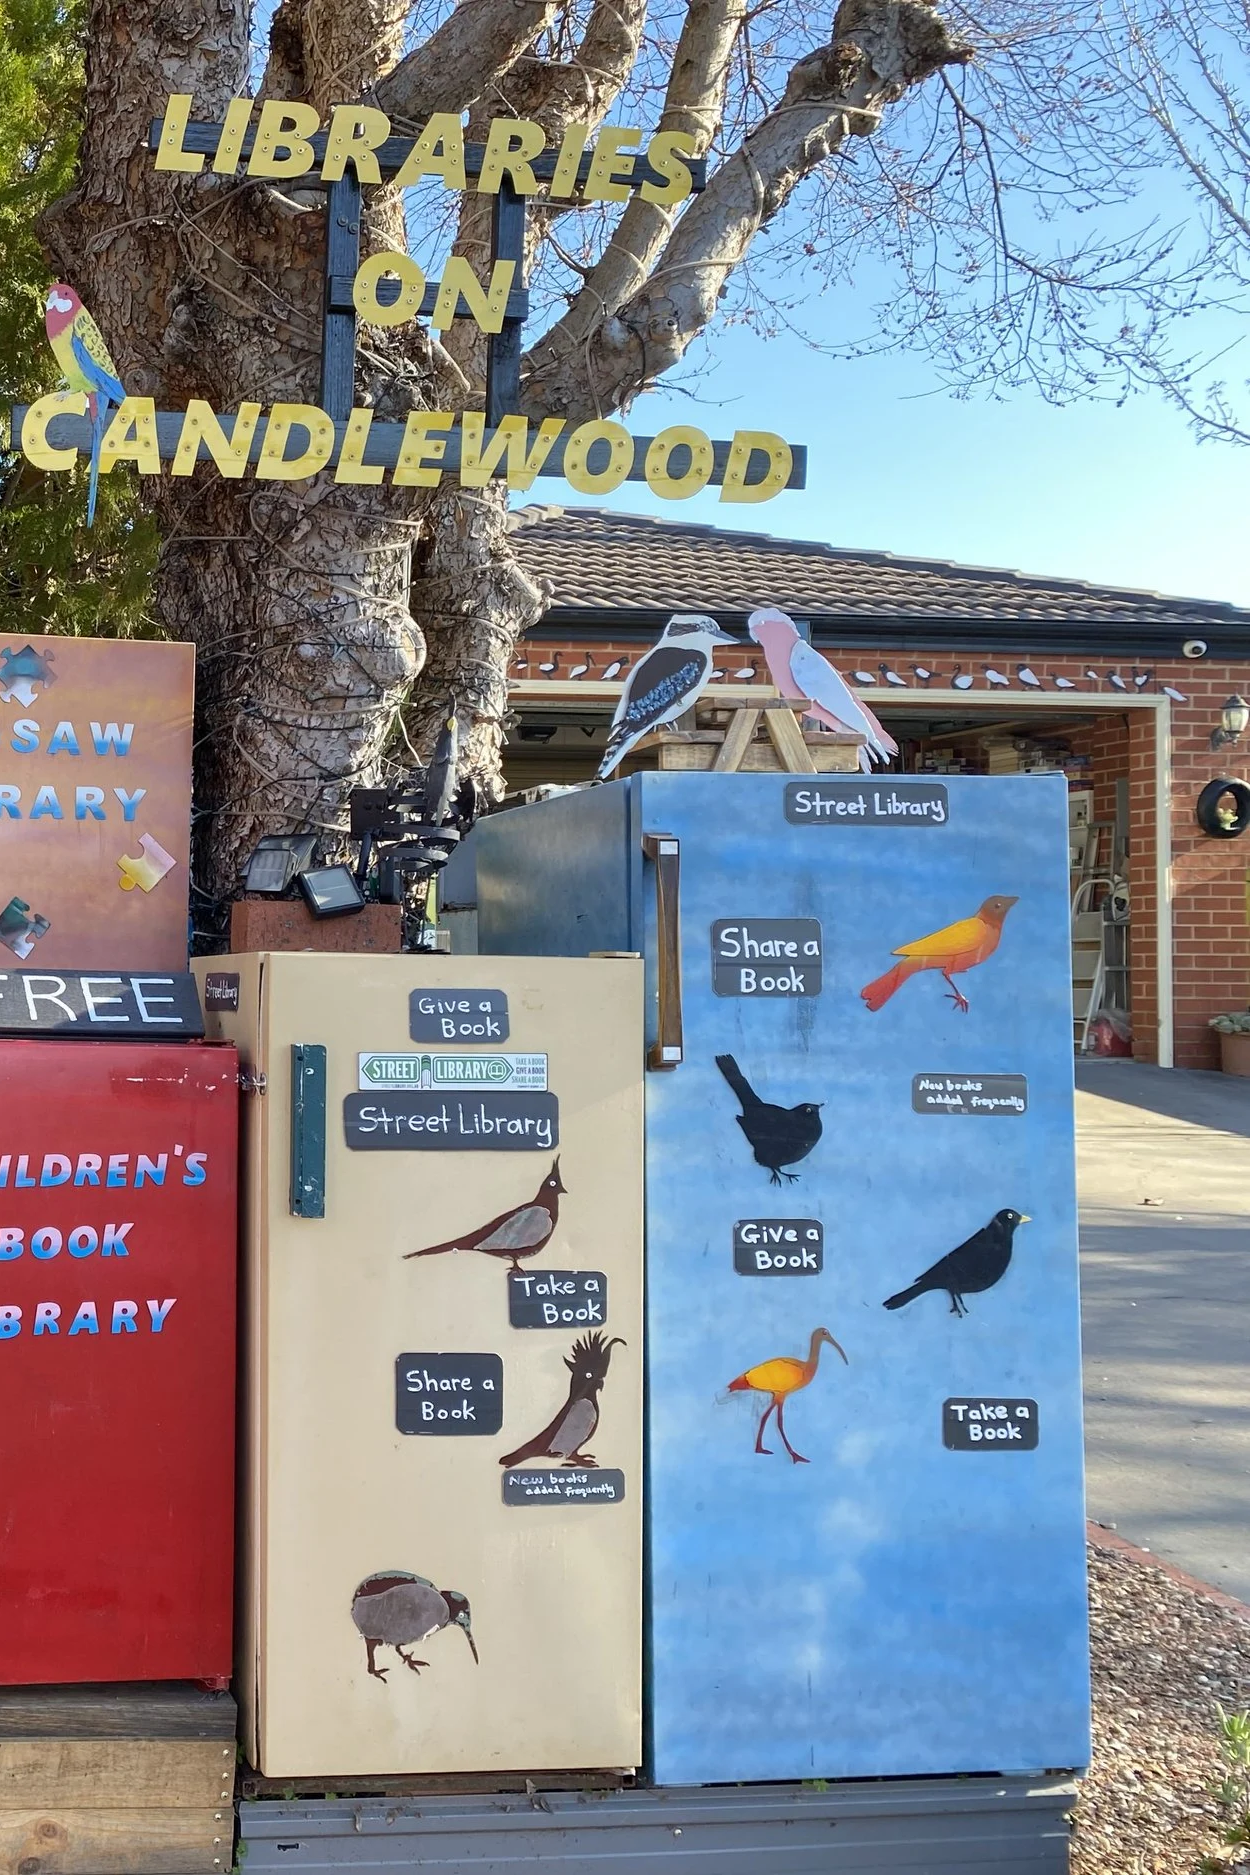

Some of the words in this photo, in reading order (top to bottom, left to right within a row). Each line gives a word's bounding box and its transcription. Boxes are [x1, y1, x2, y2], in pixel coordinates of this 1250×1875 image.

[153, 93, 697, 205] LIBRARIES
[352, 252, 516, 334] ON
[21, 391, 794, 504] CANDLEWOOD
[794, 790, 867, 816] Street
[874, 792, 945, 822] Library
[720, 927, 798, 958] Share
[803, 940, 820, 956] a
[740, 966, 805, 993] Book
[418, 997, 470, 1015] Give
[479, 999, 492, 1013] a
[441, 1016, 501, 1039] Book
[372, 1060, 416, 1079] STREET
[436, 1060, 489, 1080] LIBRARY
[515, 1057, 526, 1065] TAKE
[532, 1057, 545, 1065] BOOK
[918, 1079, 943, 1090] New
[946, 1080, 983, 1091] books
[926, 1094, 963, 1105] added
[971, 1095, 1025, 1111] frequently
[359, 1104, 451, 1134] Street
[458, 1104, 552, 1147] Library
[740, 1224, 798, 1244] Give
[806, 1229, 819, 1240] a
[755, 1247, 817, 1270] Book
[514, 1274, 576, 1297] Take
[584, 1279, 599, 1292] a
[542, 1299, 602, 1324] Book
[406, 1369, 473, 1392] Share
[482, 1379, 495, 1391] a
[421, 1399, 476, 1421] Book
[950, 1403, 1008, 1421] Take
[1015, 1406, 1030, 1419] a
[969, 1421, 1022, 1441] Book
[509, 1475, 543, 1486] New
[549, 1473, 588, 1484] books
[525, 1485, 561, 1495] added
[564, 1483, 616, 1498] frequently
